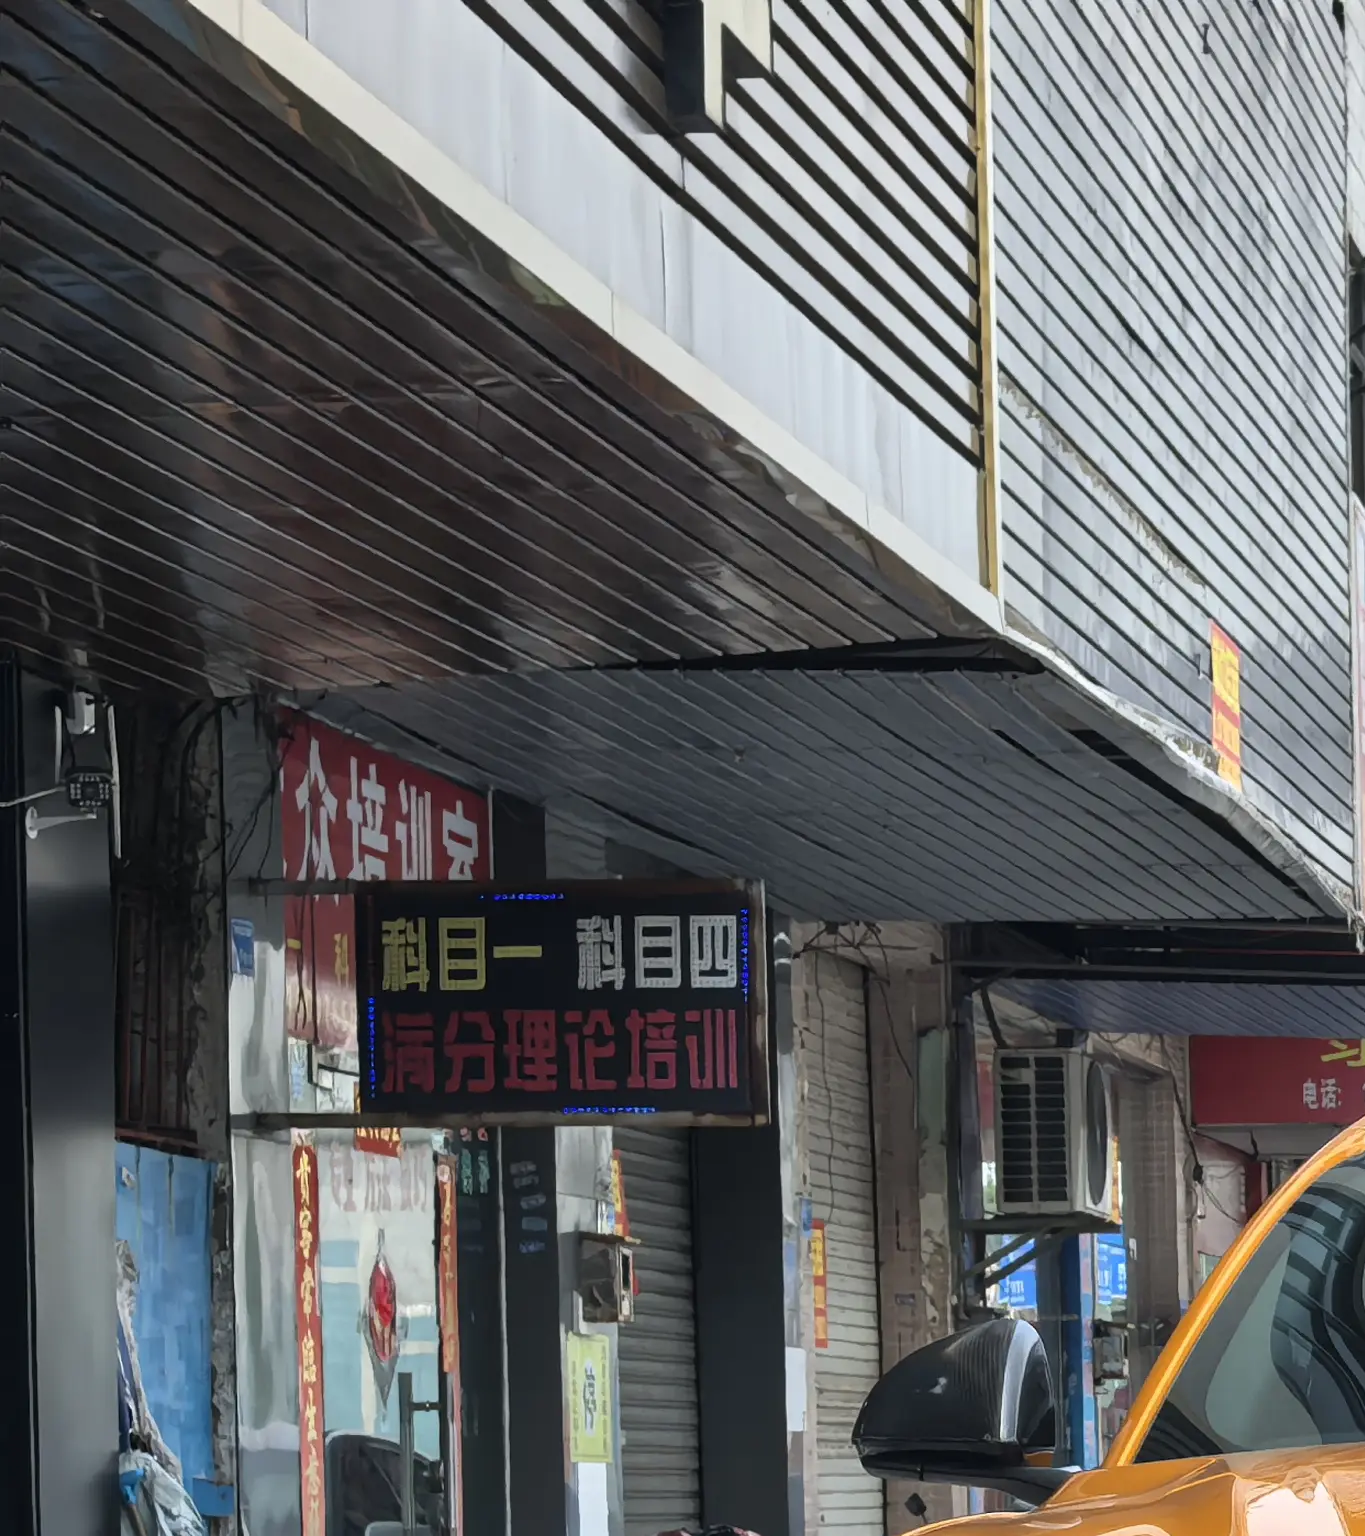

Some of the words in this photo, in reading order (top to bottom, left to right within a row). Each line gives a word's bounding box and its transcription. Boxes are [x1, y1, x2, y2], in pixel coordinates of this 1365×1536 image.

[280, 737, 478, 881] 众培训室
[381, 916, 542, 992] 科目一
[576, 914, 737, 990] 科目四
[381, 1008, 738, 1094] 满分理论培训
